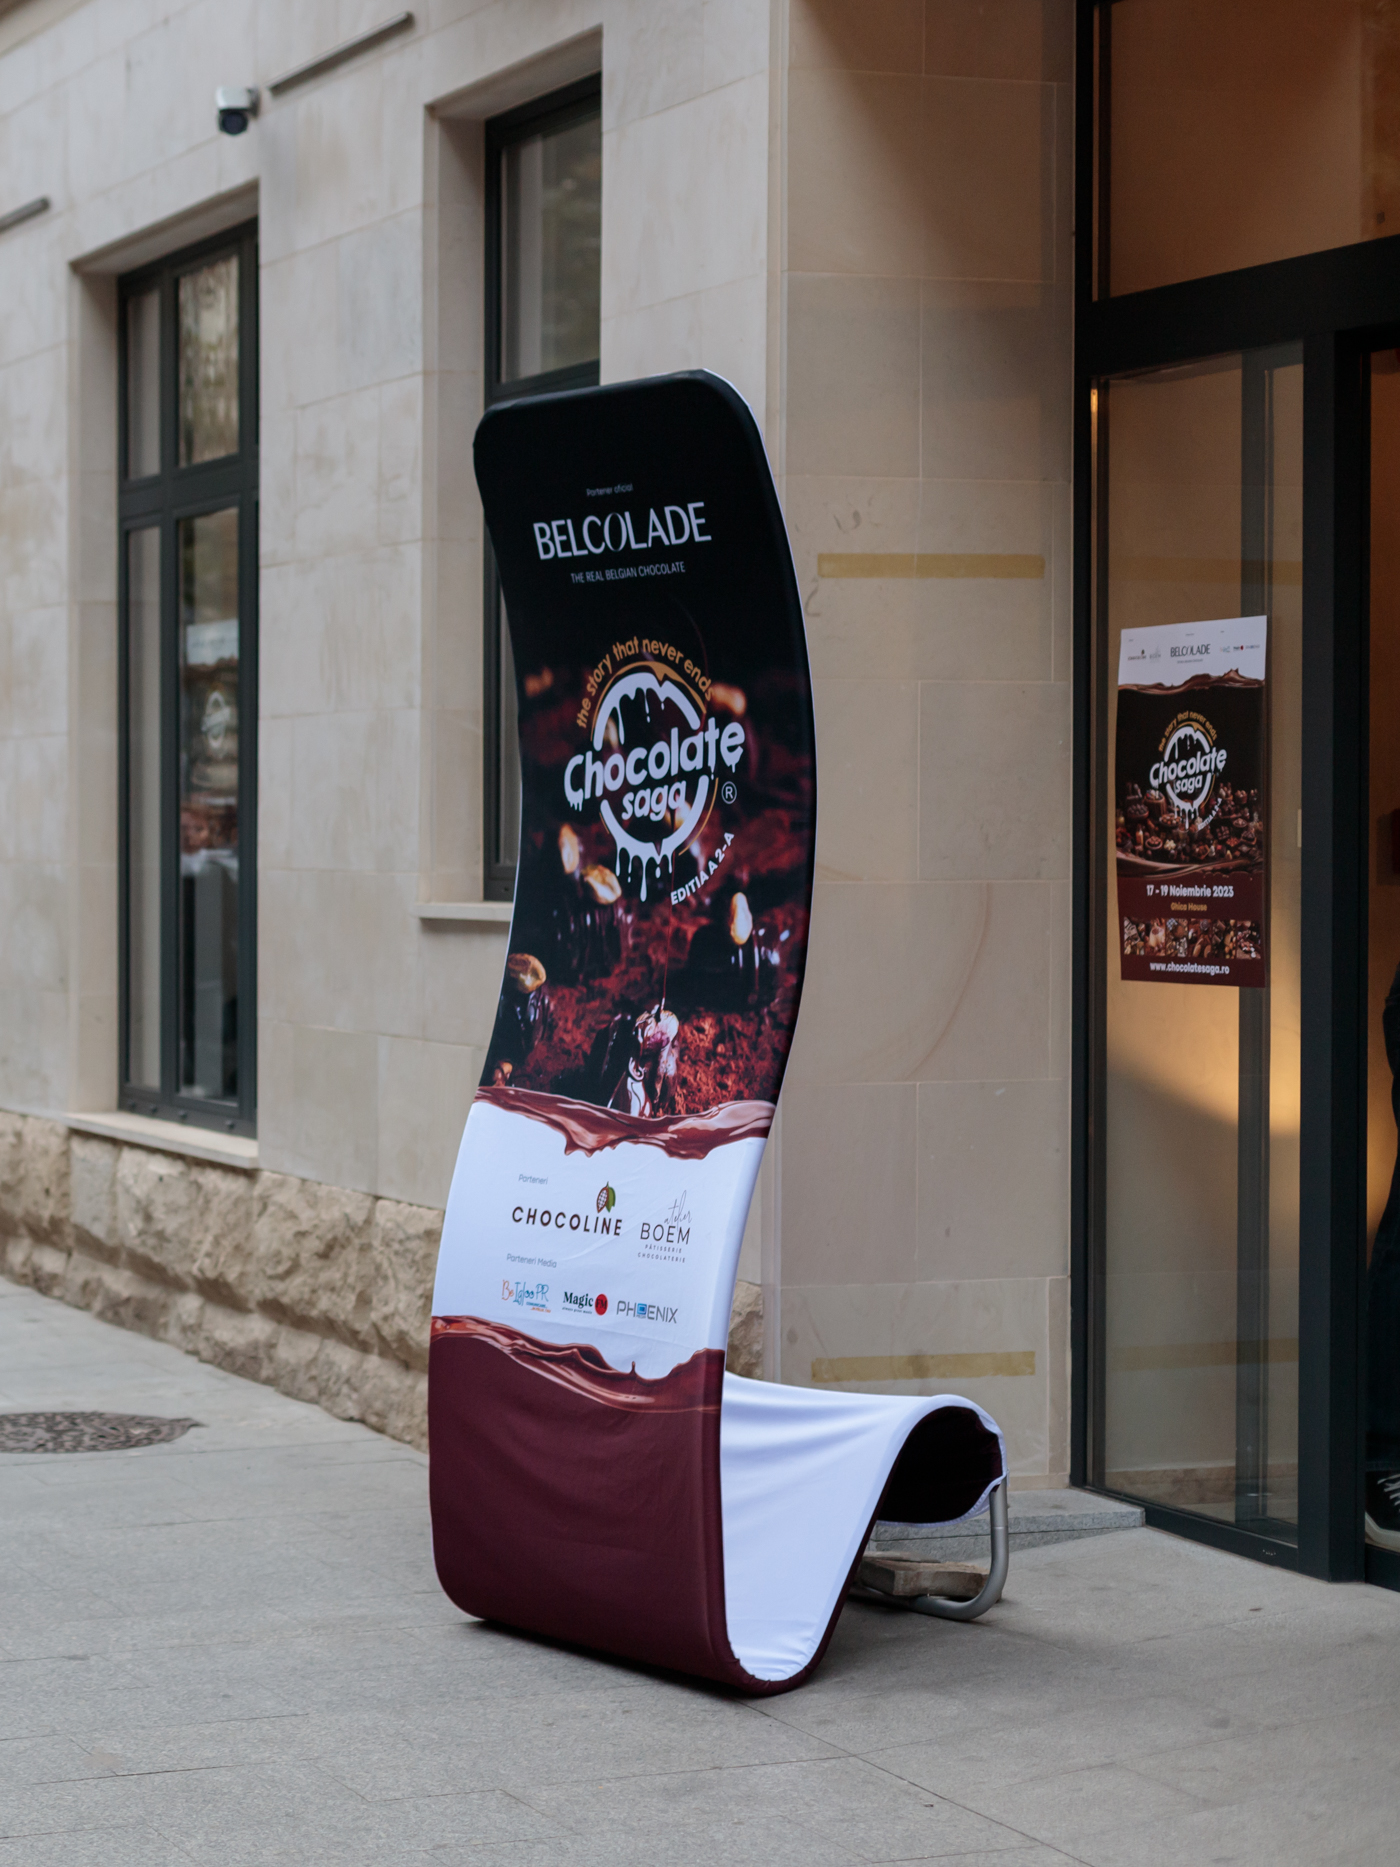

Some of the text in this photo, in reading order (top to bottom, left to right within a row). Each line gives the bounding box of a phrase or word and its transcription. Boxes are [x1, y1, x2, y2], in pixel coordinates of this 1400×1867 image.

[533, 501, 712, 560] BELCOLADE
[570, 561, 686, 584] THE REAL BELGIAN CHOCOLATE
[1170, 644, 1211, 657] BELCOLADE
[576, 636, 713, 728] the story that never ends
[564, 716, 746, 811] Chocolate
[1149, 747, 1227, 789] Chocolate
[1175, 775, 1202, 794] saga
[621, 780, 687, 822] saga
[670, 832, 734, 906] EDITIA A 2-A
[1146, 884, 1154, 896] 17
[1160, 884, 1169, 897] 19
[1169, 884, 1211, 897] Noiembrie
[1212, 885, 1234, 898] 2023
[1188, 903, 1208, 911] House
[1149, 961, 1230, 976] www.chocolatesaga.ro
[518, 1174, 548, 1185] Parteneri
[511, 1206, 623, 1237] CHOCOLINE
[640, 1222, 690, 1245] BOEM
[506, 1253, 558, 1268] Parteneri Media
[563, 1291, 608, 1310] Magic FM
